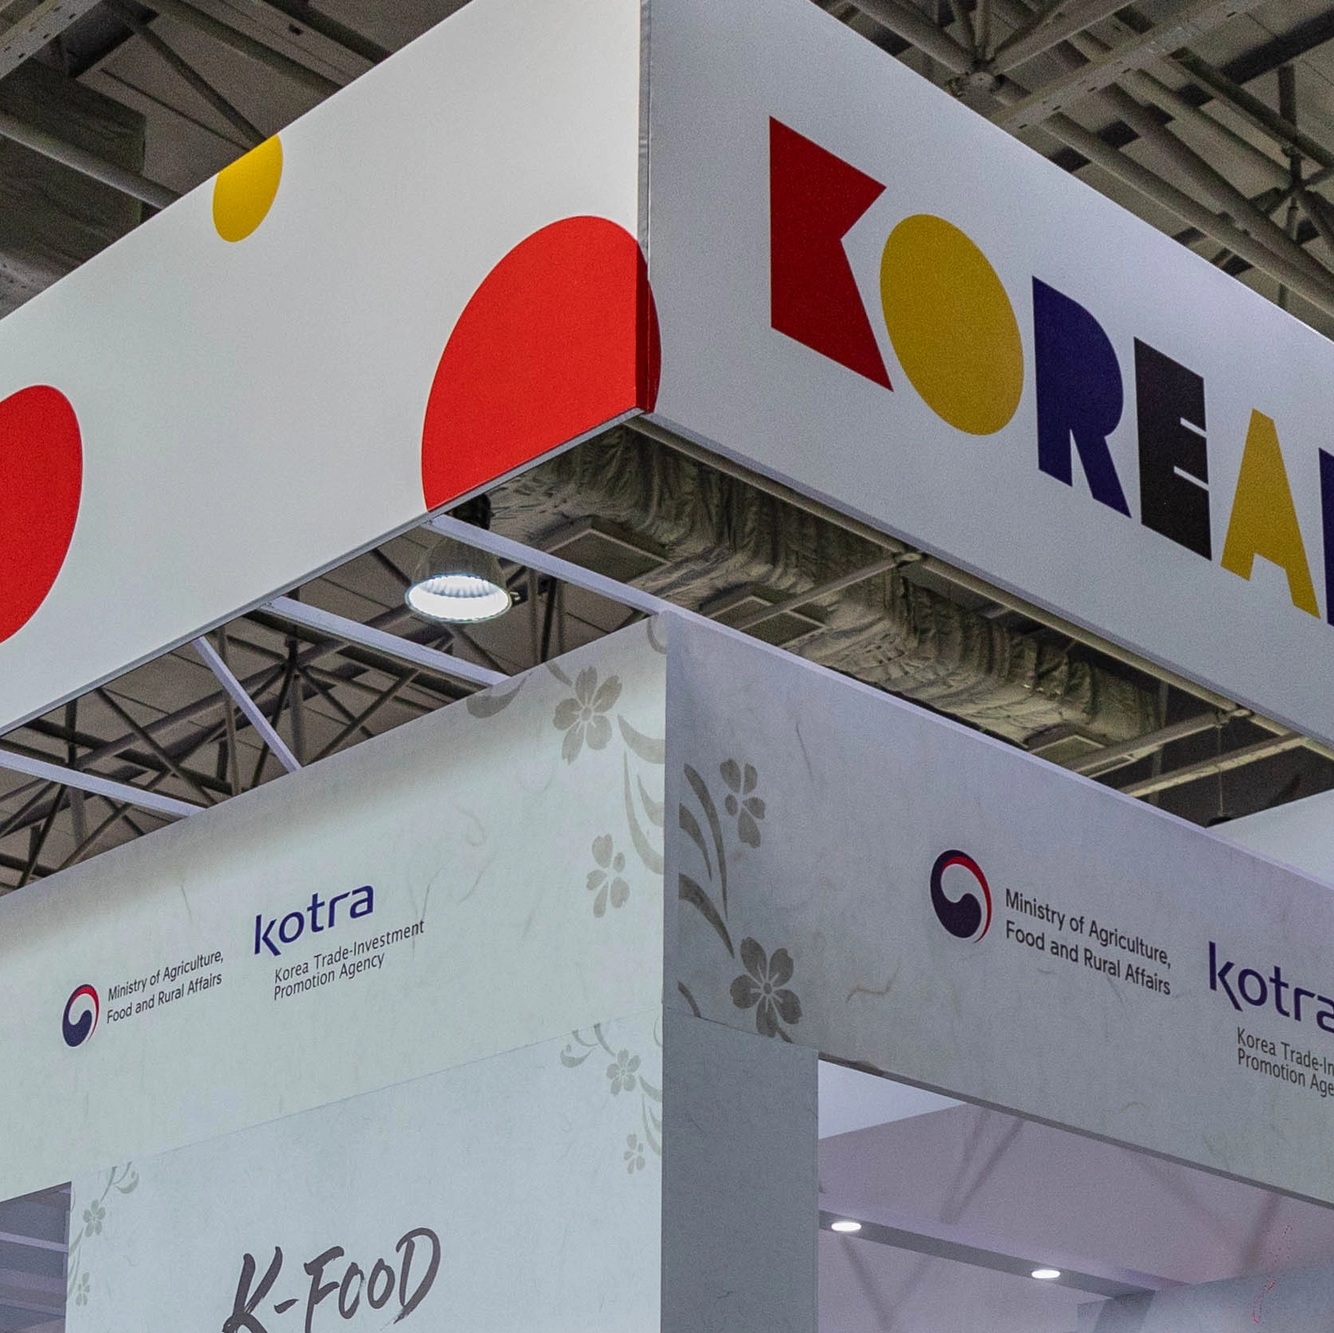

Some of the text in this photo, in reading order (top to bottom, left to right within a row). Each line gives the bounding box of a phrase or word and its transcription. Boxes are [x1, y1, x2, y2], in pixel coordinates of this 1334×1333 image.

[254, 884, 374, 957] kotra
[1005, 888, 1172, 969] Ministry of Agriculture,
[108, 949, 224, 1002] Ministry of Agriculture,
[273, 951, 386, 1001] Promotion Agency
[274, 919, 426, 984] Korea Trade-Investment
[1005, 920, 1171, 996] Food and Rural Affairs
[106, 971, 223, 1025] Food and Rural Affairs
[1236, 1026, 1277, 1057] Korea
[1237, 1048, 1307, 1086] Promotion
